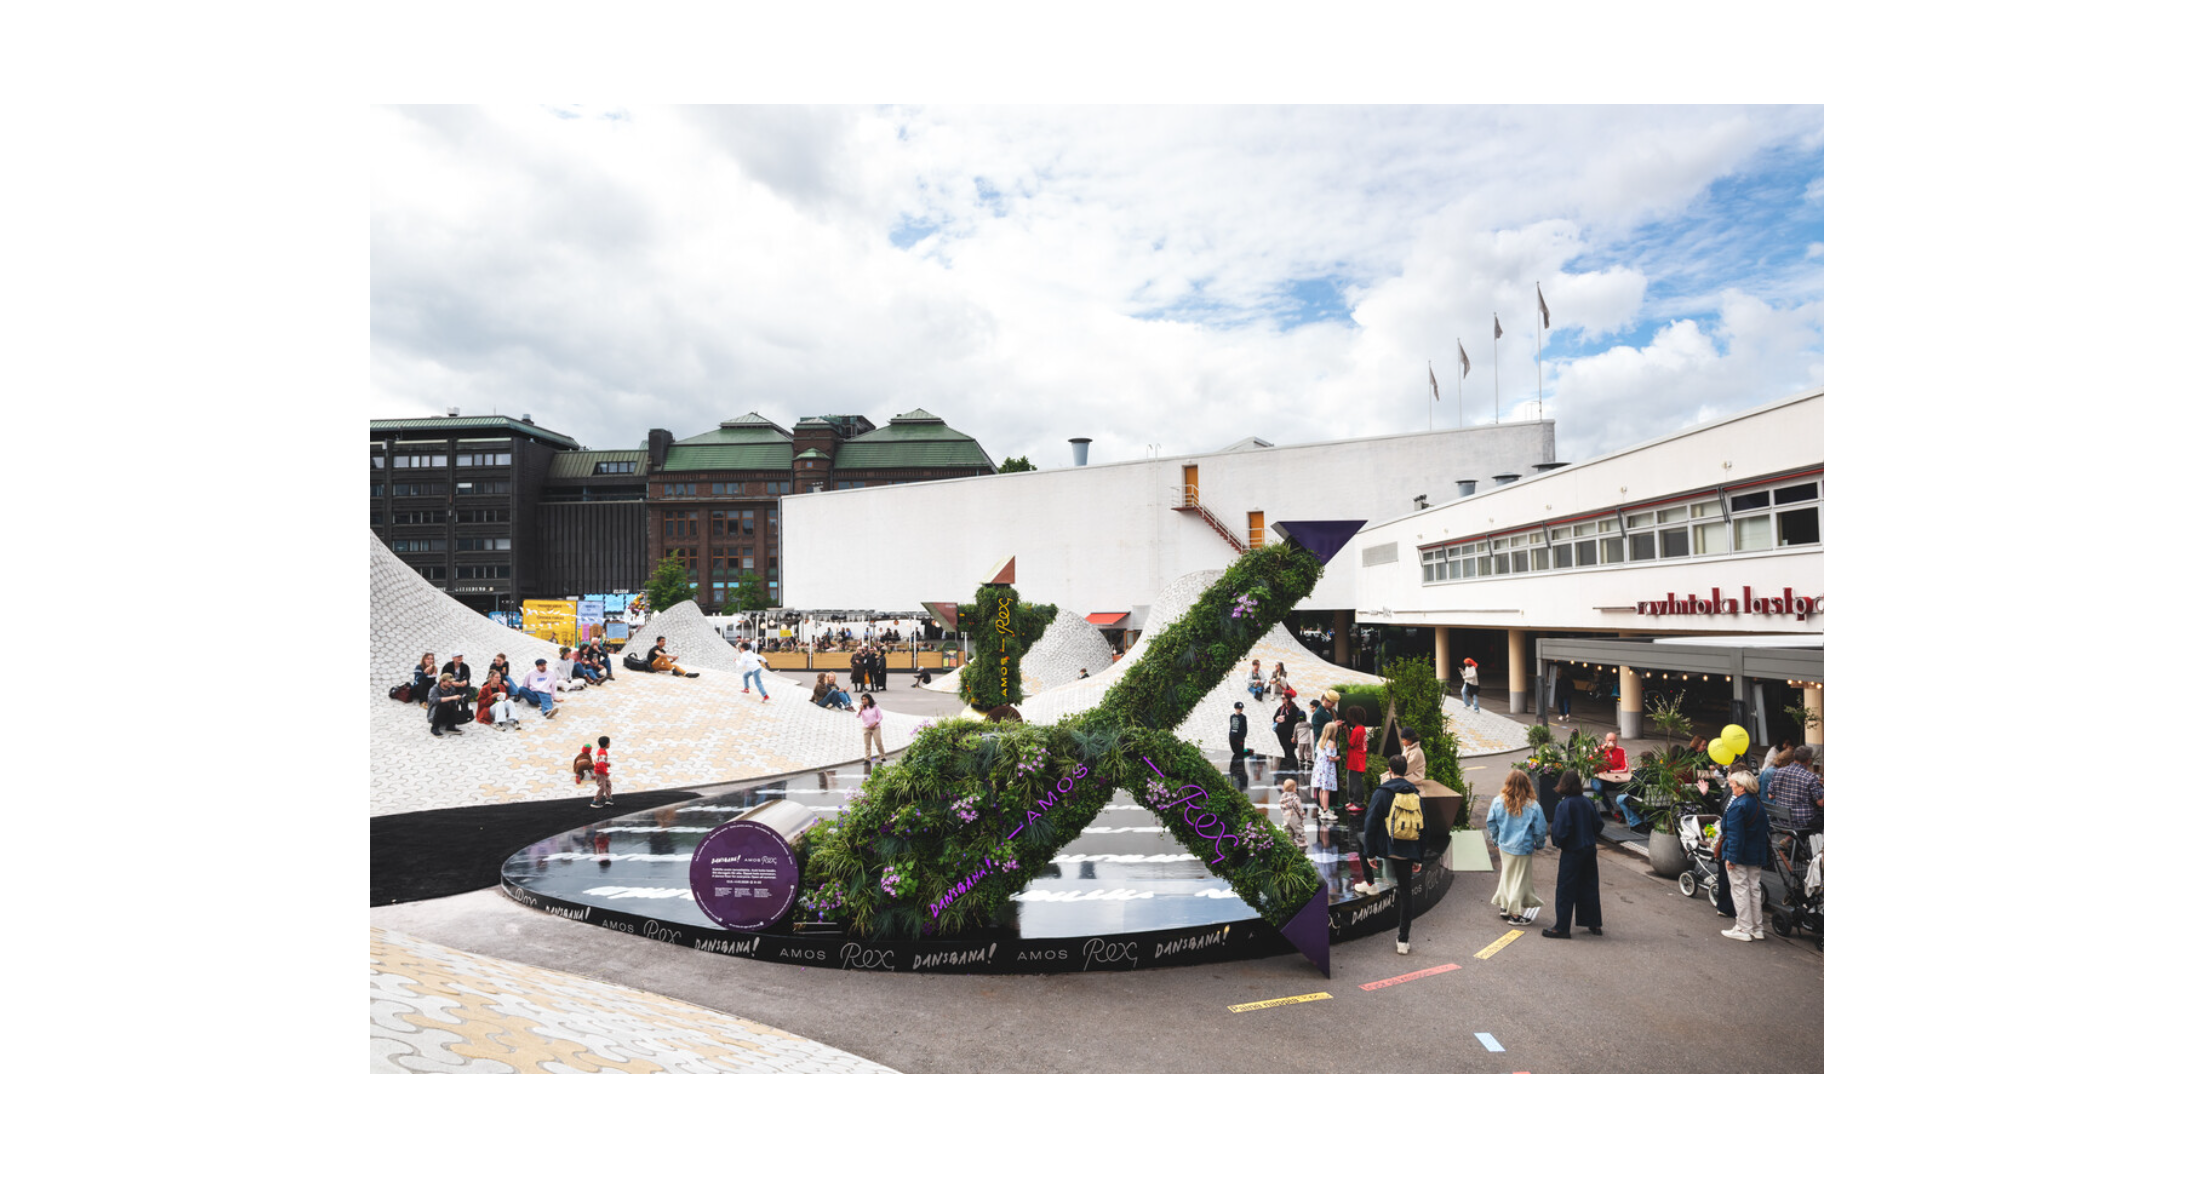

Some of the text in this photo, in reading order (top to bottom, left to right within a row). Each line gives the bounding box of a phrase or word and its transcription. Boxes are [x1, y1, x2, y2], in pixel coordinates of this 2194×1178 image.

[995, 598, 1014, 697] AMOS Rex
[930, 763, 1088, 918] DANSBANA! AMOS
[1159, 784, 1239, 865] Rex
[602, 919, 635, 933] AMOS
[694, 937, 760, 958] DANSBANA!
[779, 948, 826, 960] AMOS
[840, 942, 895, 972] Rex
[912, 942, 997, 970] DANSBANA!
[1017, 950, 1068, 961] AMOS
[1083, 937, 1138, 972] Rex
[1155, 924, 1231, 959] DANSBANA!
